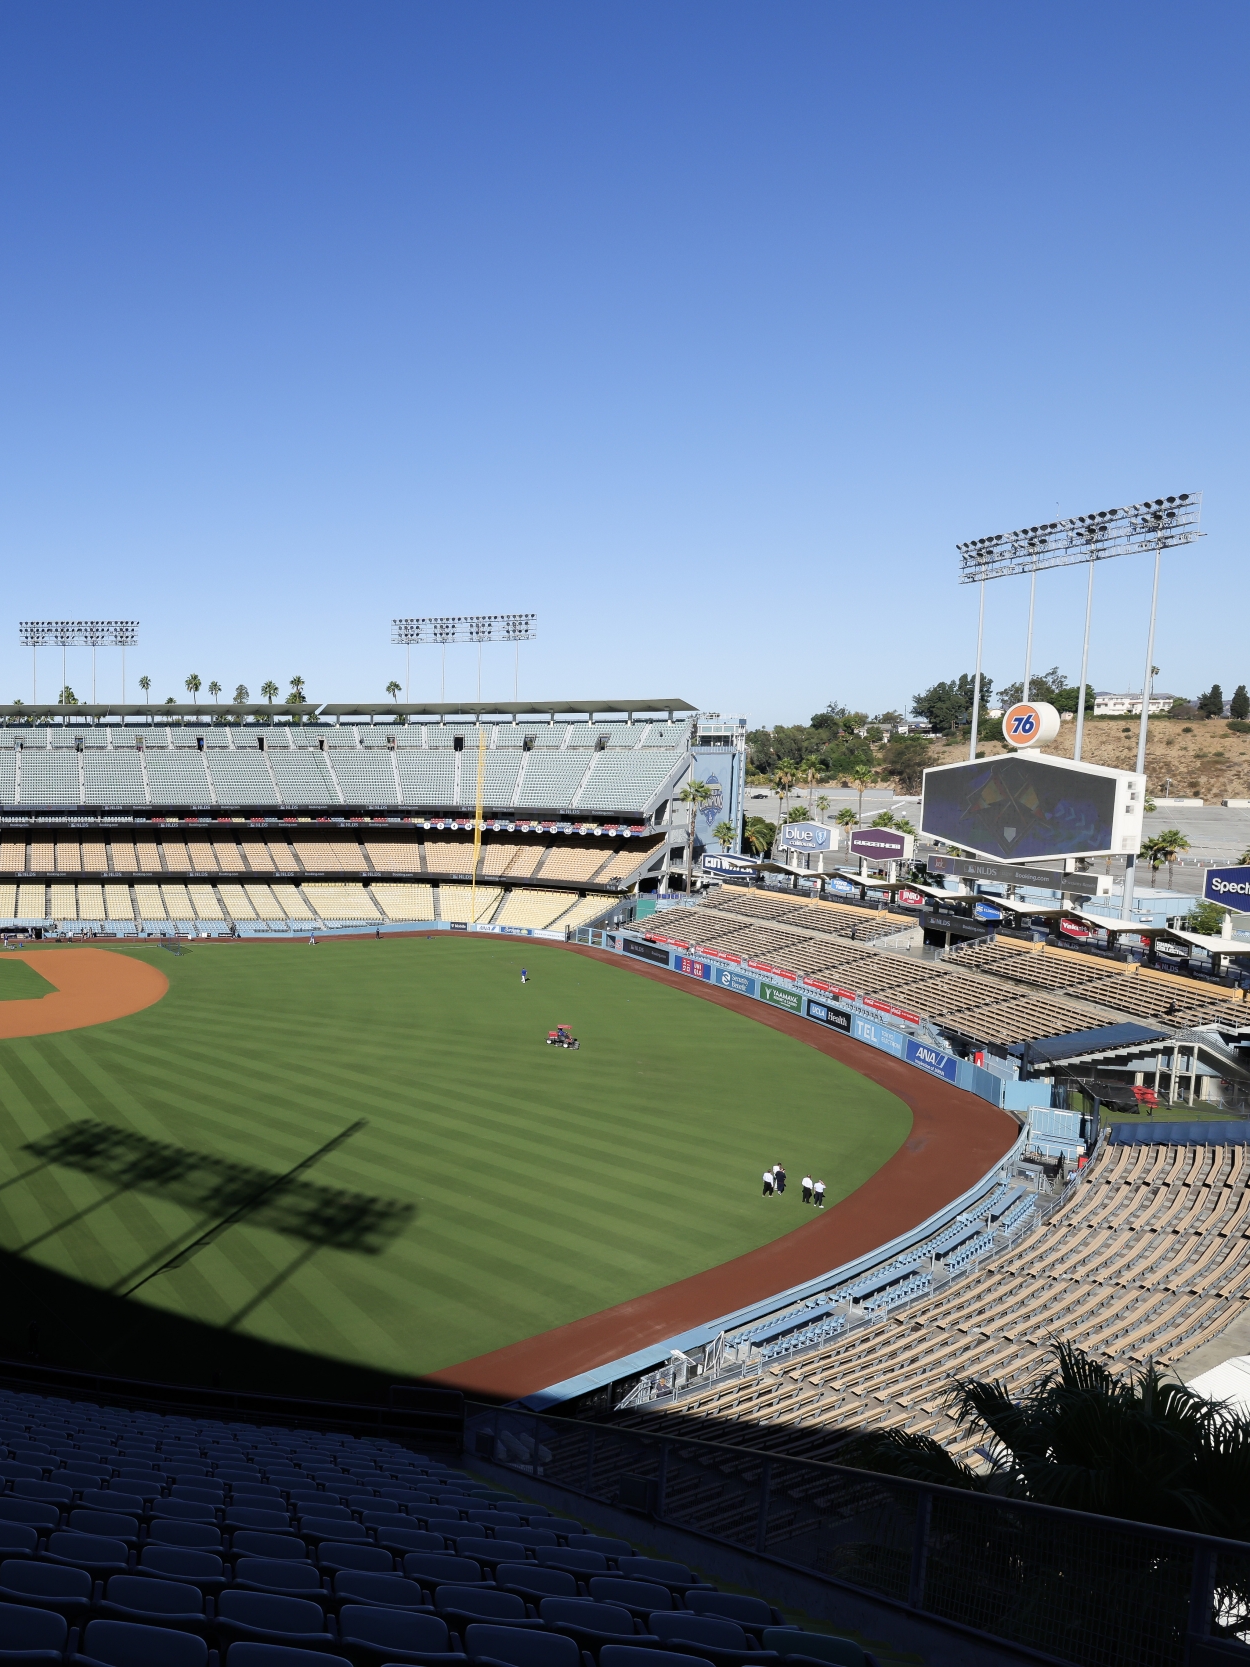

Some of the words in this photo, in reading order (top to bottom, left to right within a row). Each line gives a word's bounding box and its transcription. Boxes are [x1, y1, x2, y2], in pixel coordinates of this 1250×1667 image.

[1011, 713, 1036, 735] 76
[786, 826, 813, 841] blue
[789, 840, 816, 848] california
[853, 839, 901, 850] GUGGENHEIM
[976, 867, 997, 876] NLDS
[1015, 872, 1049, 883] Booking.com
[1062, 922, 1088, 933] Yakult
[1161, 963, 1178, 973] NLDS
[731, 974, 749, 986] Security
[731, 980, 747, 991] Benefit
[812, 1005, 825, 1016] UCLA
[827, 1011, 848, 1026] Health
[857, 1020, 877, 1042] TEL
[915, 1047, 936, 1065] ANA
